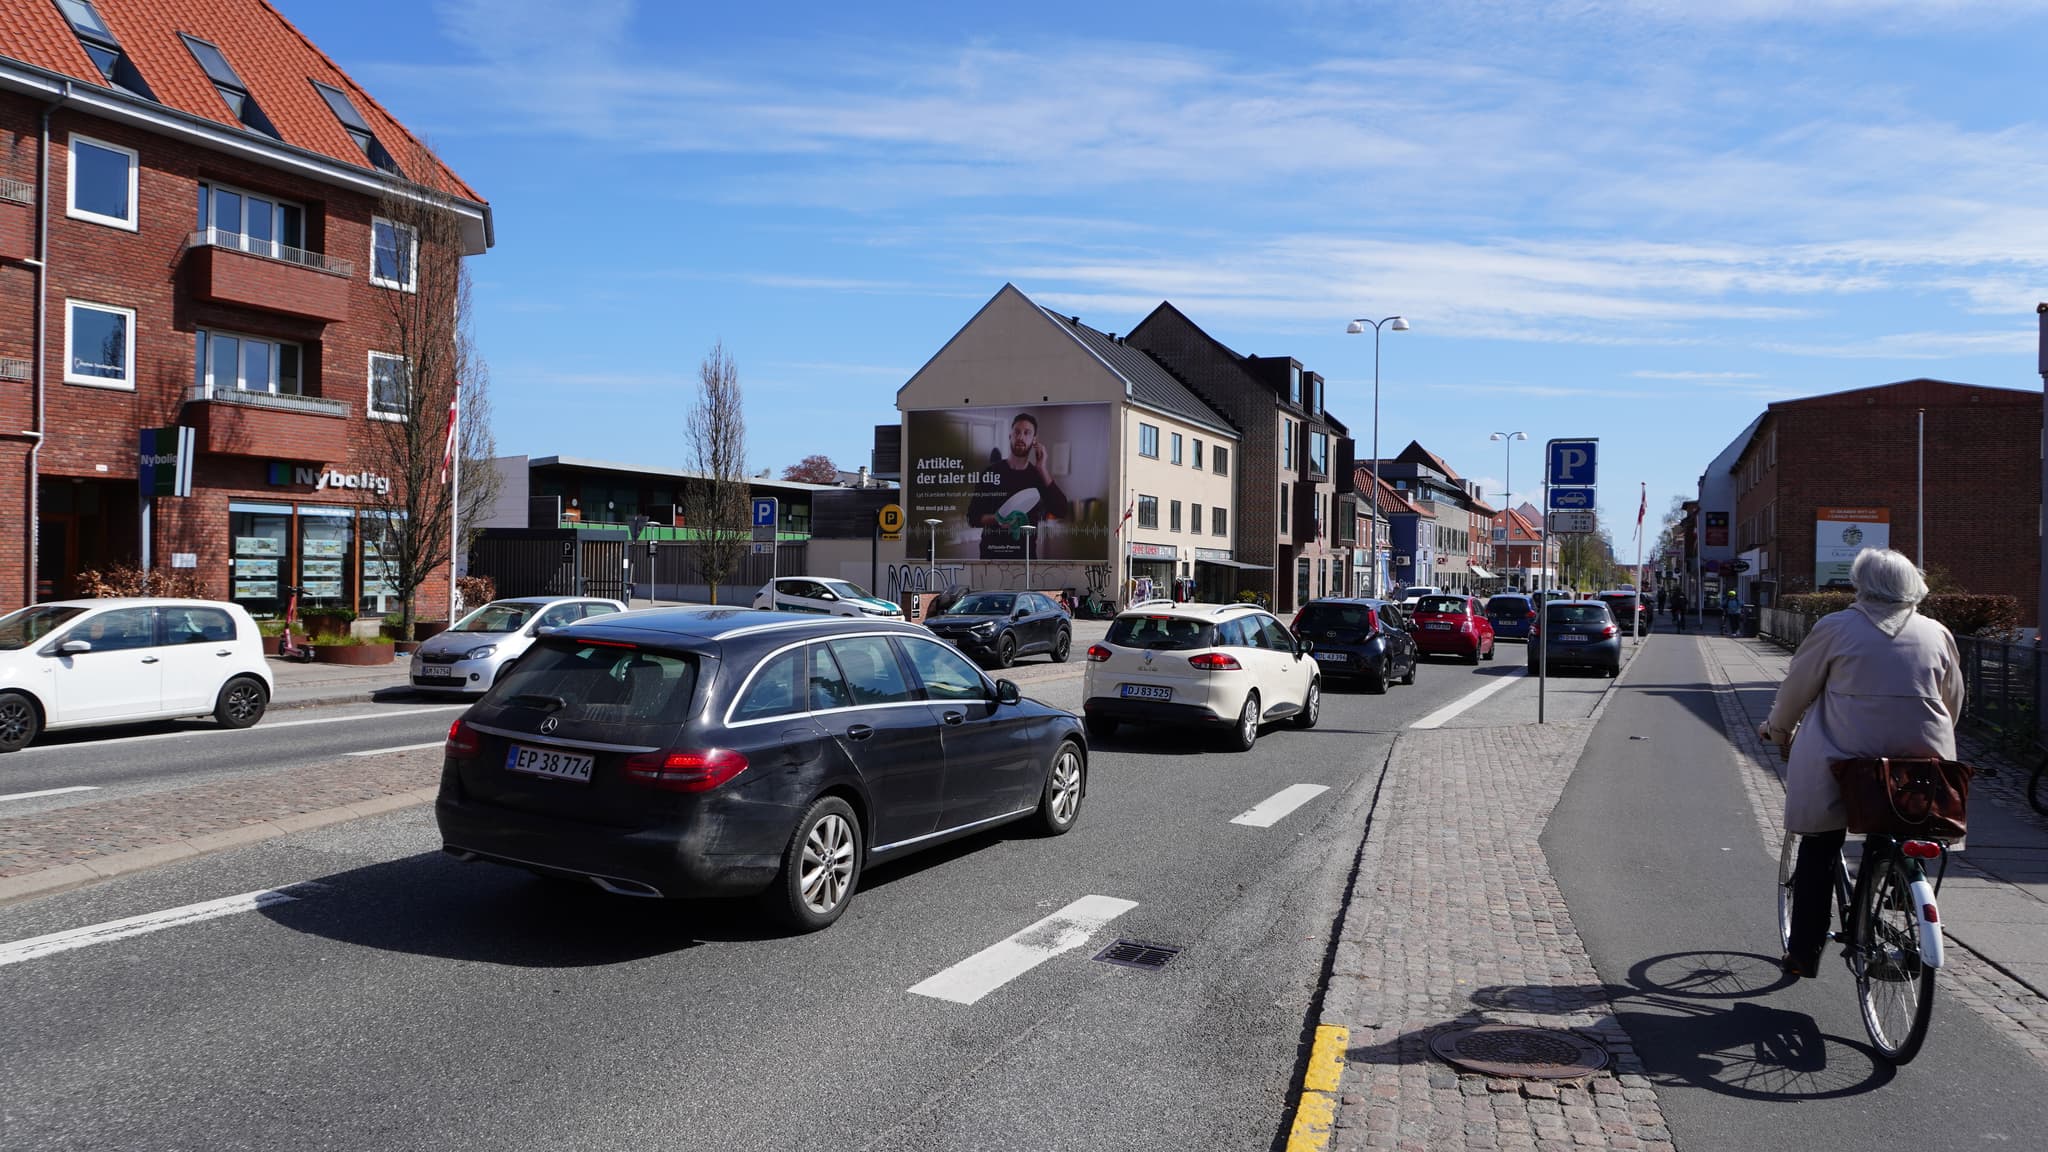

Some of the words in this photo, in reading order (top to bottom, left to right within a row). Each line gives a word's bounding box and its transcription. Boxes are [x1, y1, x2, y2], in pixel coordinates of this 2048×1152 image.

[916, 457, 965, 470] Artikler,
[1558, 449, 1588, 480] P
[295, 467, 390, 495] Nybolig
[916, 473, 937, 484] der
[938, 472, 966, 484] taler
[967, 471, 981, 483] til
[982, 471, 1001, 486] dig
[758, 503, 771, 523] P
[887, 512, 895, 524] P
[564, 543, 571, 555] P
[913, 595, 919, 609] P
[1127, 686, 1140, 696] DJ
[1140, 687, 1152, 697] 83
[1153, 688, 1170, 698] 525
[517, 750, 539, 769] EP
[539, 753, 561, 773] 38
[561, 756, 592, 778] 774
